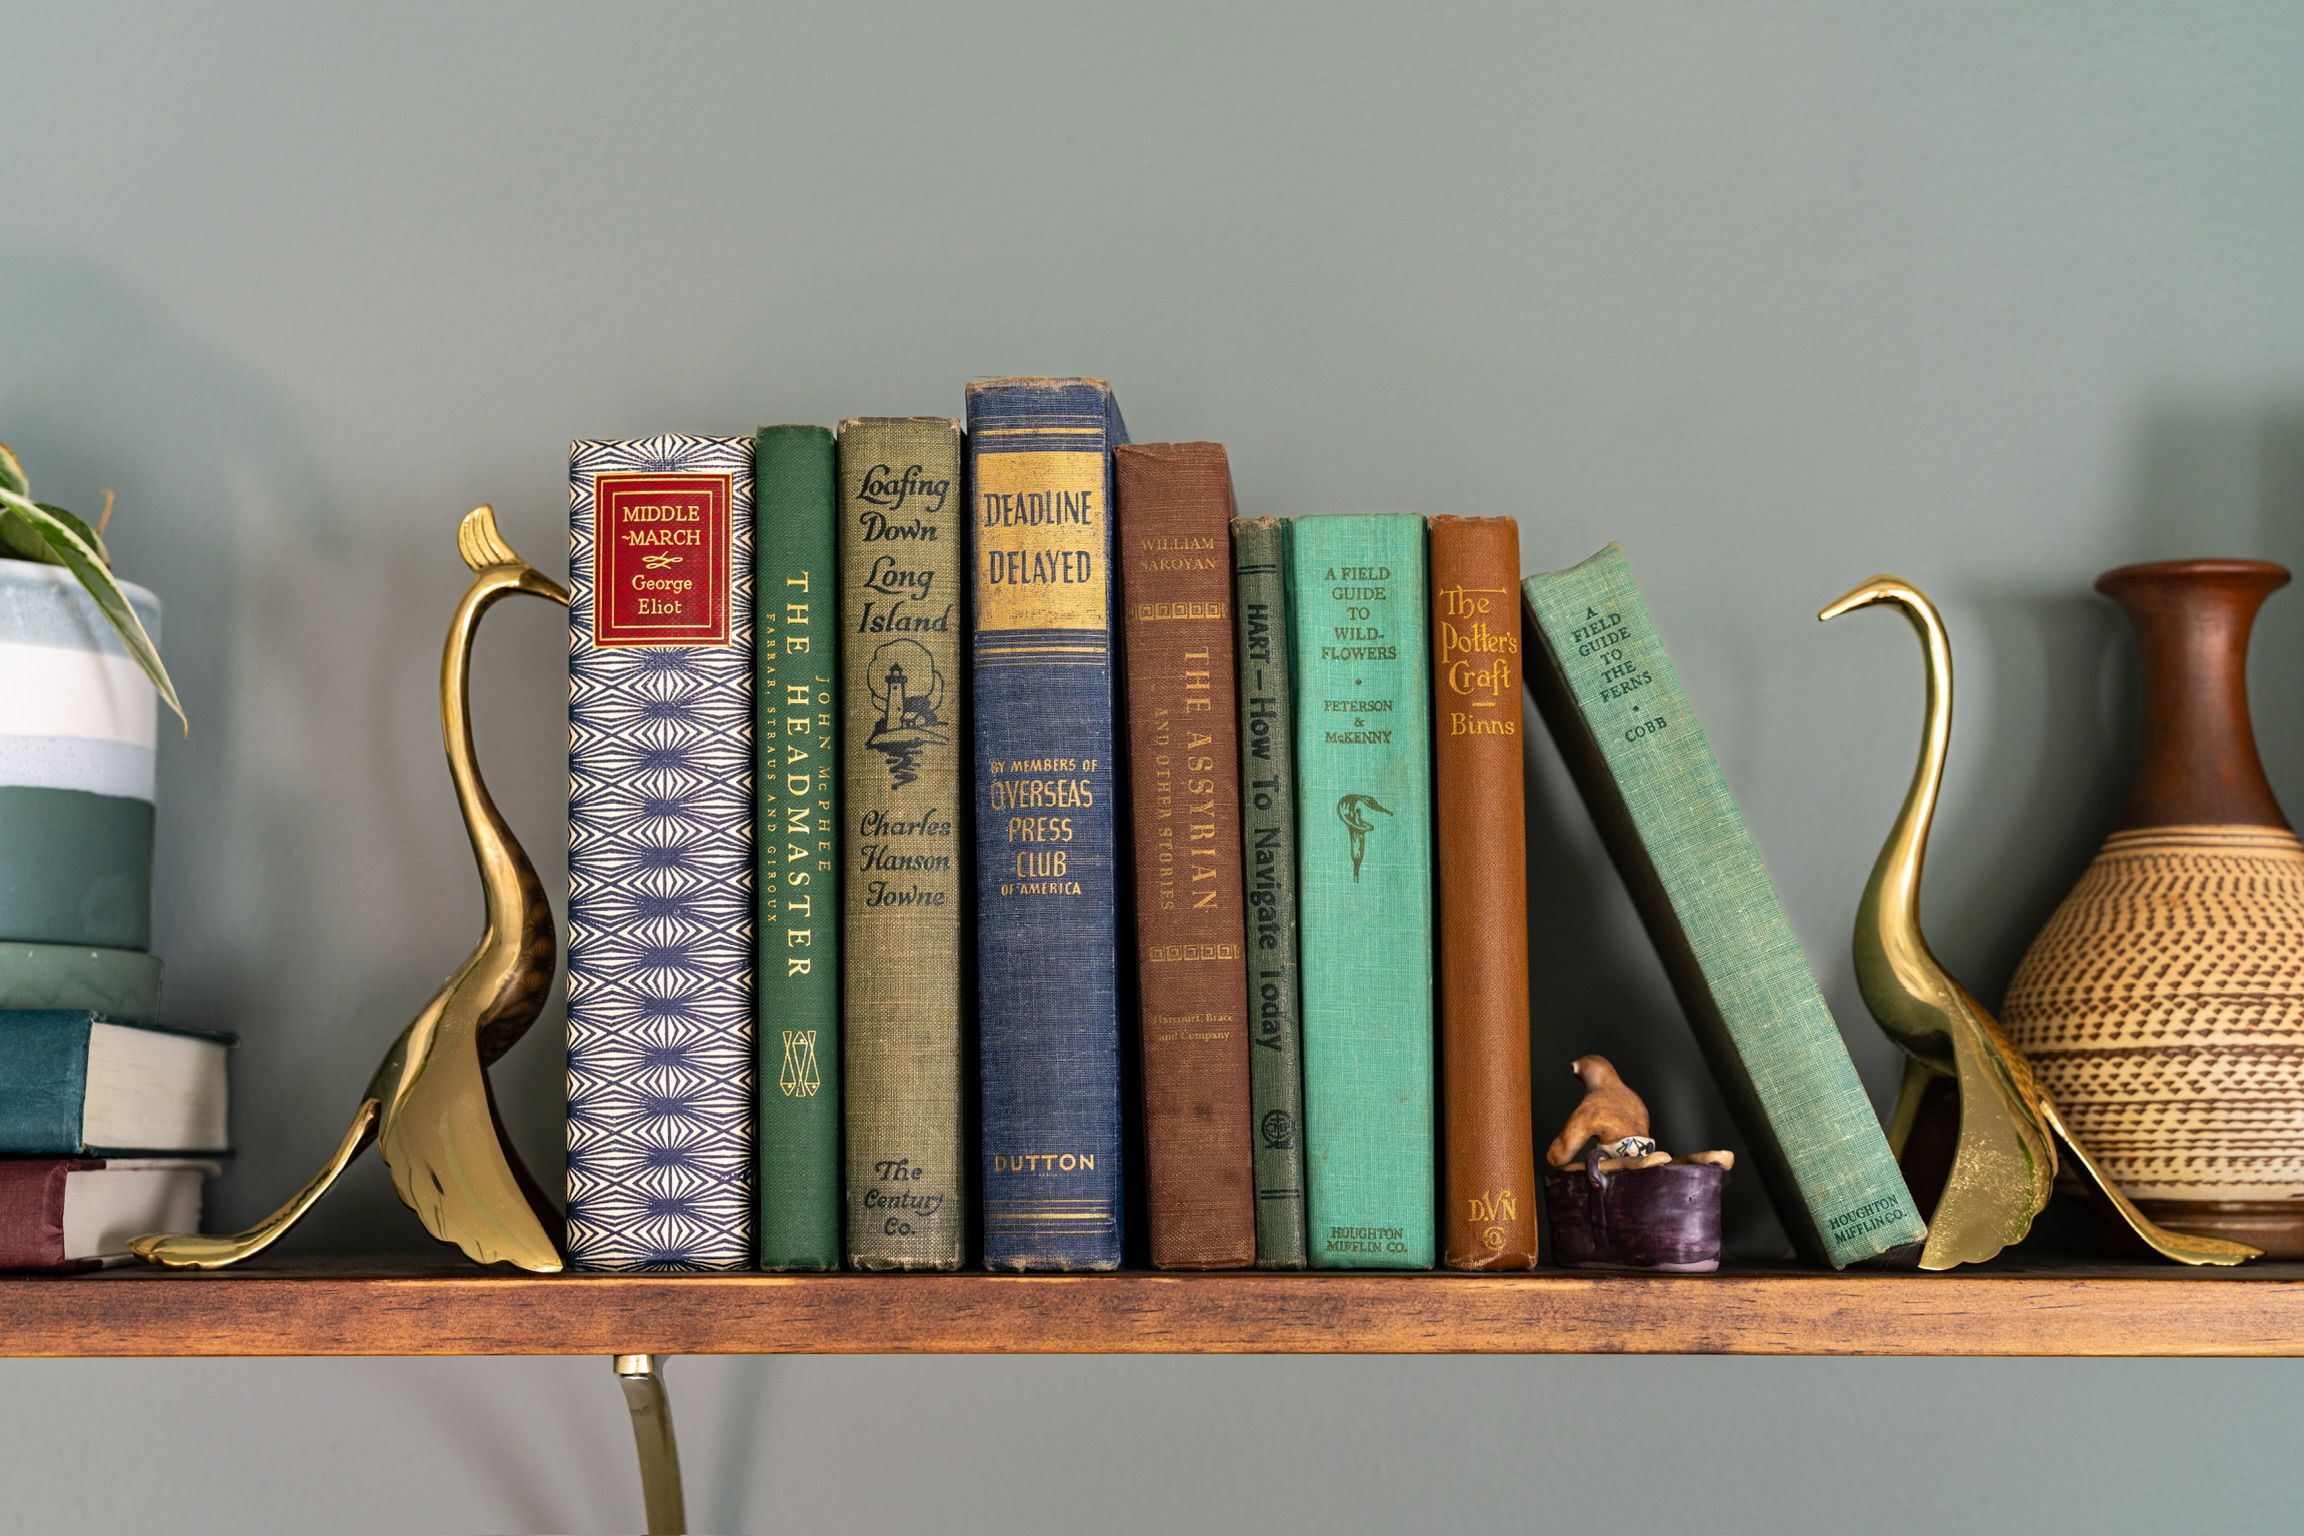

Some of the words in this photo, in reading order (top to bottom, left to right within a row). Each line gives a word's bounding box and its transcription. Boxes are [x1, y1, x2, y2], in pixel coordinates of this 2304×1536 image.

[856, 464, 950, 512] Loafing
[622, 506, 700, 522] MIDDLE
[983, 490, 1092, 527] DEADLINE
[859, 511, 937, 541] Down
[1143, 537, 1214, 551] WILLIAM
[863, 556, 935, 600] Long
[989, 550, 1091, 585] DELAYED
[1140, 558, 1216, 570] SAROYAN
[1325, 567, 1336, 580] A
[1341, 567, 1391, 580] FIELD
[631, 575, 693, 594] George
[1331, 587, 1387, 600] GUIDE
[638, 599, 682, 614] Eliot
[786, 571, 810, 654] THE
[1347, 607, 1370, 620] TO
[1440, 585, 1508, 619] The
[1586, 606, 1598, 620] A
[857, 601, 953, 633] Island
[1571, 613, 1621, 643] FIELD
[1247, 604, 1271, 664] HART
[1334, 627, 1385, 641] WILD-
[1440, 621, 1517, 664] Potter's
[1578, 627, 1631, 657] GUIDE
[1321, 646, 1397, 660] FLOWERS
[1600, 649, 1623, 665] TO
[1184, 646, 1211, 713] THE
[1449, 659, 1511, 695] Craft
[1601, 660, 1637, 684] THE
[1600, 671, 1652, 703] FERNS
[815, 675, 831, 750] JOHN
[1324, 700, 1393, 712] PETERSON
[1155, 707, 1170, 746] AND
[1354, 716, 1365, 728] &
[1450, 712, 1514, 735] Binns
[1625, 717, 1668, 742] COBB
[767, 707, 778, 781] STRAUS
[990, 760, 1006, 774] BY
[1011, 758, 1076, 773] MEMBERS
[1083, 759, 1098, 773] OF
[991, 779, 1093, 811] OVERSEAS
[1156, 755, 1172, 819] OTHER
[1252, 774, 1279, 811] To
[767, 795, 777, 831] AND
[860, 808, 952, 836] Charles
[1187, 731, 1218, 909] ASSYRIAN
[786, 685, 811, 977] HEADMASTER
[1008, 817, 1073, 843] PRESS
[860, 845, 950, 871] Hanson
[1017, 851, 1067, 878] CLUB
[1158, 827, 1174, 910] STORIES
[767, 846, 777, 922] GIROUX
[866, 881, 945, 906] Towne
[1001, 884, 1015, 896] OF
[1020, 881, 1082, 896] AMERICA
[1249, 827, 1282, 950] Navigate
[1255, 966, 1283, 1052] Today
[1158, 1031, 1178, 1042] and
[1180, 1030, 1231, 1042] Company
[875, 1158, 923, 1181] The
[993, 1153, 1095, 1172] DUTTON
[863, 1189, 944, 1216] Century
[1829, 1194, 1899, 1230] HOUGHTON
[884, 1217, 916, 1235] Co.
[1330, 1226, 1404, 1239] HOUGHTON
[1833, 1216, 1886, 1244] MIFFLIN
[1885, 1209, 1908, 1223] CO.
[1326, 1240, 1382, 1252] MIFFLIN
[1386, 1242, 1408, 1254] CO.
